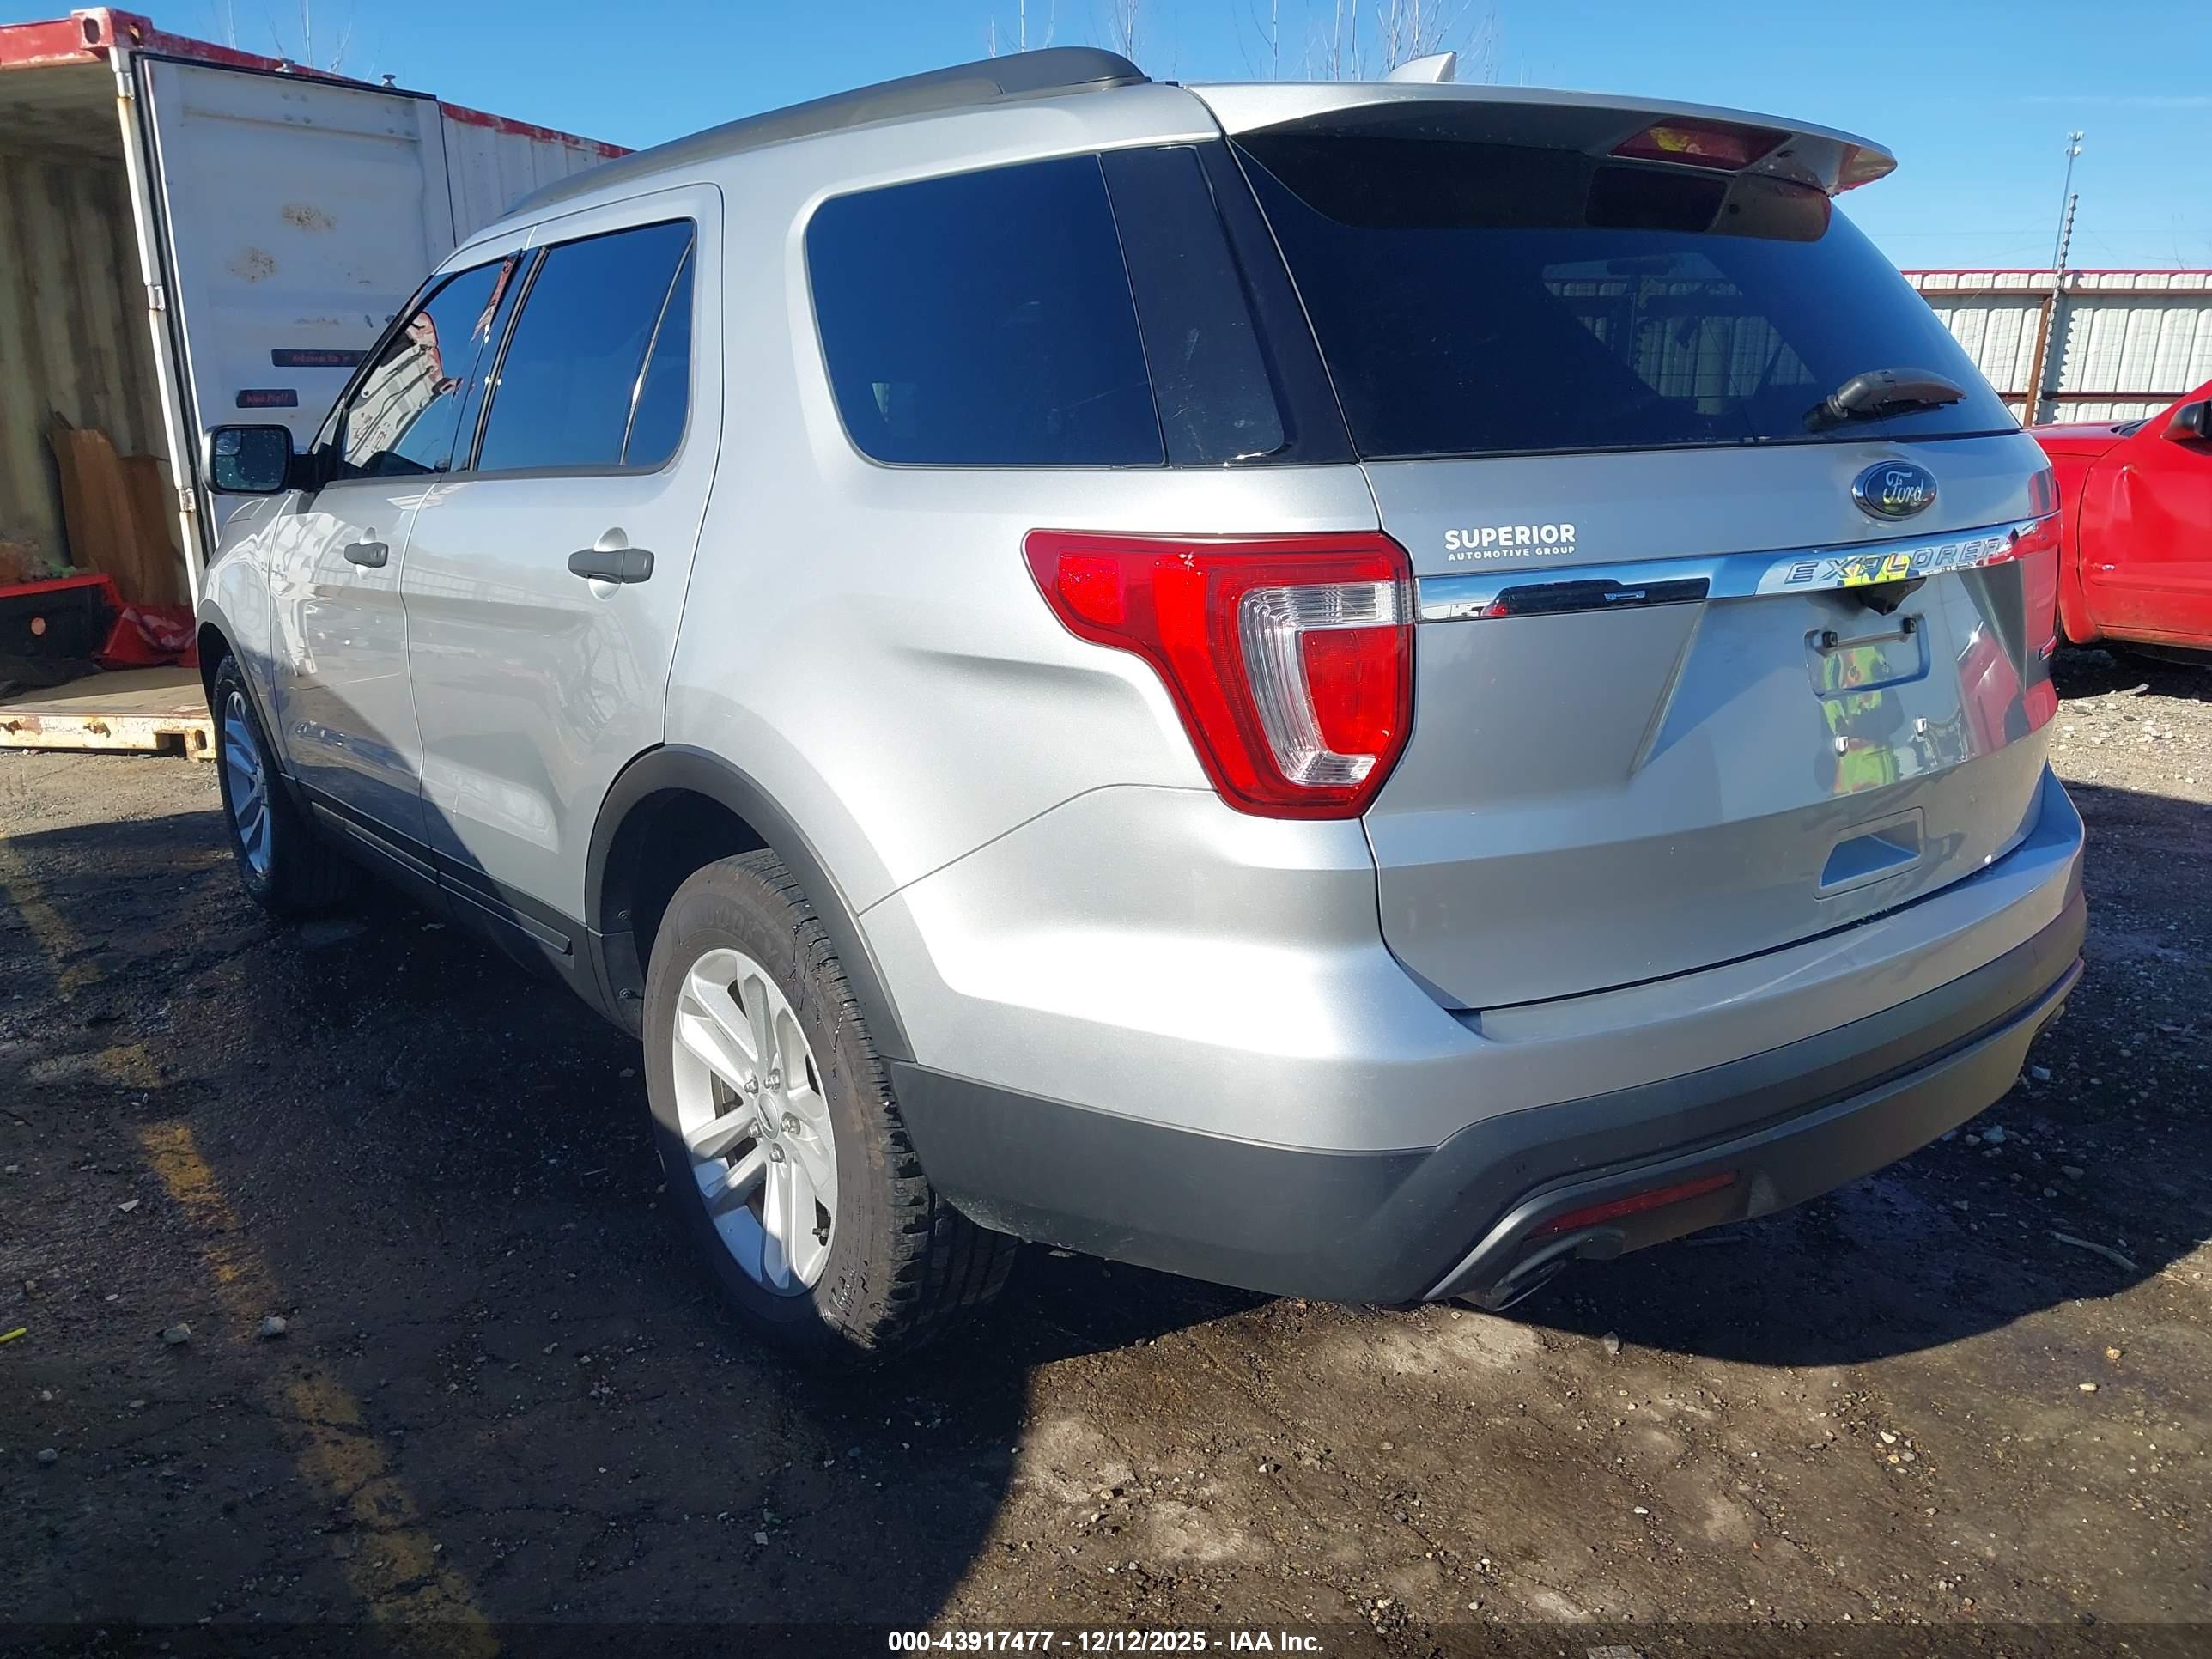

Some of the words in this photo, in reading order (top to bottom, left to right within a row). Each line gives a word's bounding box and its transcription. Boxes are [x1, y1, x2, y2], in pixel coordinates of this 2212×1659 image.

[1882, 470, 1929, 505] Ford
[1444, 523, 1576, 550] SUPERIOR
[1448, 548, 1530, 562] AUTOMOTIVE
[1535, 545, 1576, 556] GROUP
[1784, 537, 2005, 585] EXPLORER
